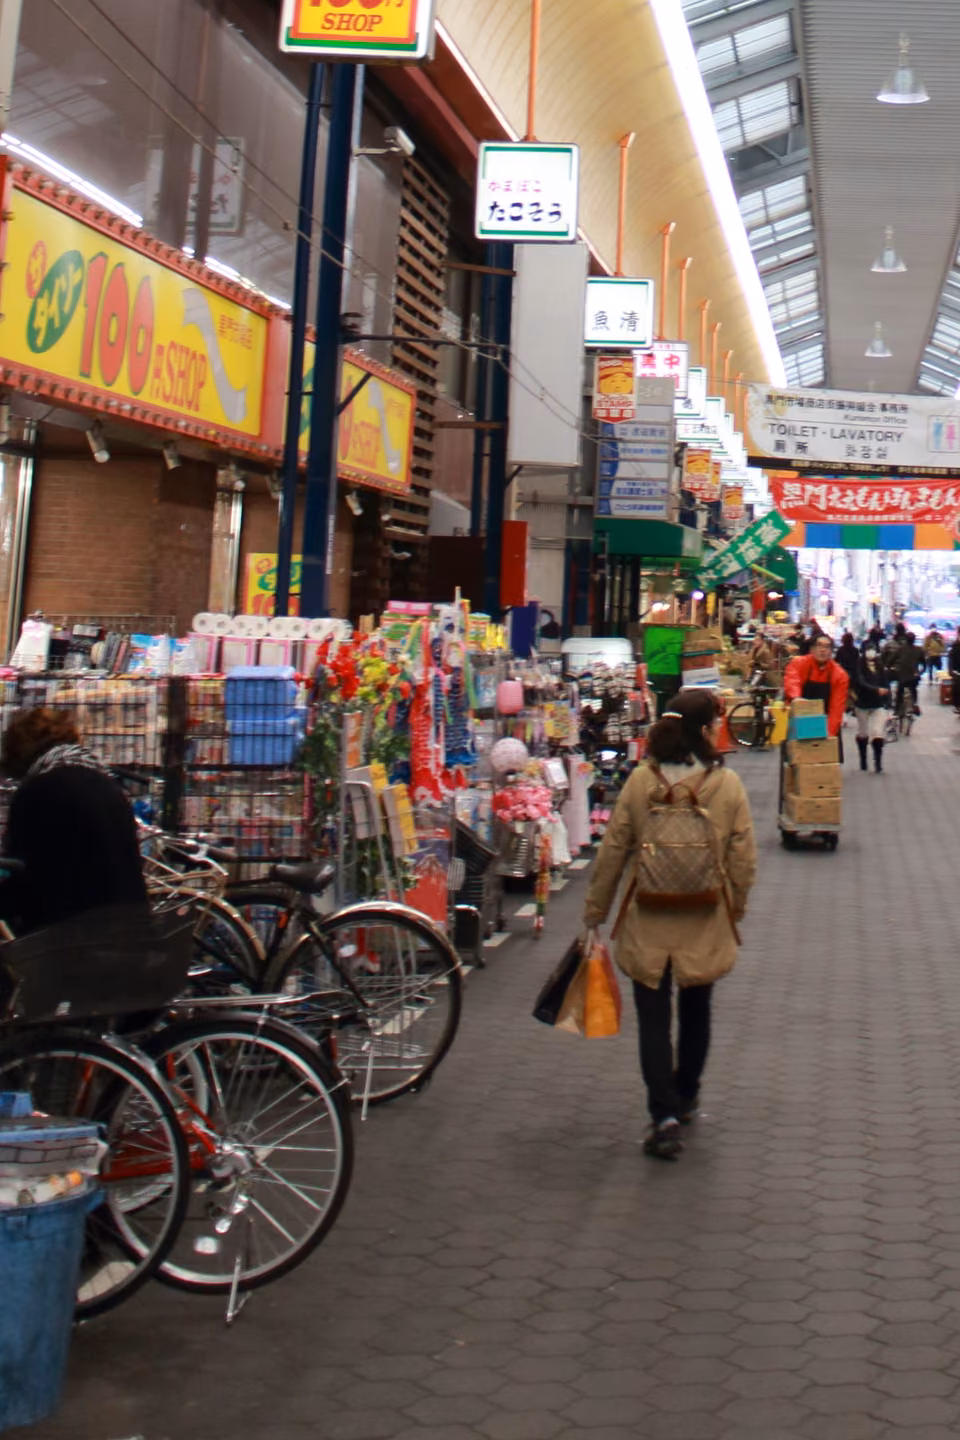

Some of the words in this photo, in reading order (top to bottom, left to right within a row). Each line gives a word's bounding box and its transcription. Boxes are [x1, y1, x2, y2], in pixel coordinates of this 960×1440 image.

[321, 12, 383, 32] SHOP
[488, 201, 563, 223] たこそう
[768, 423, 819, 438] TOILET
[829, 427, 904, 443] LAVATORY
